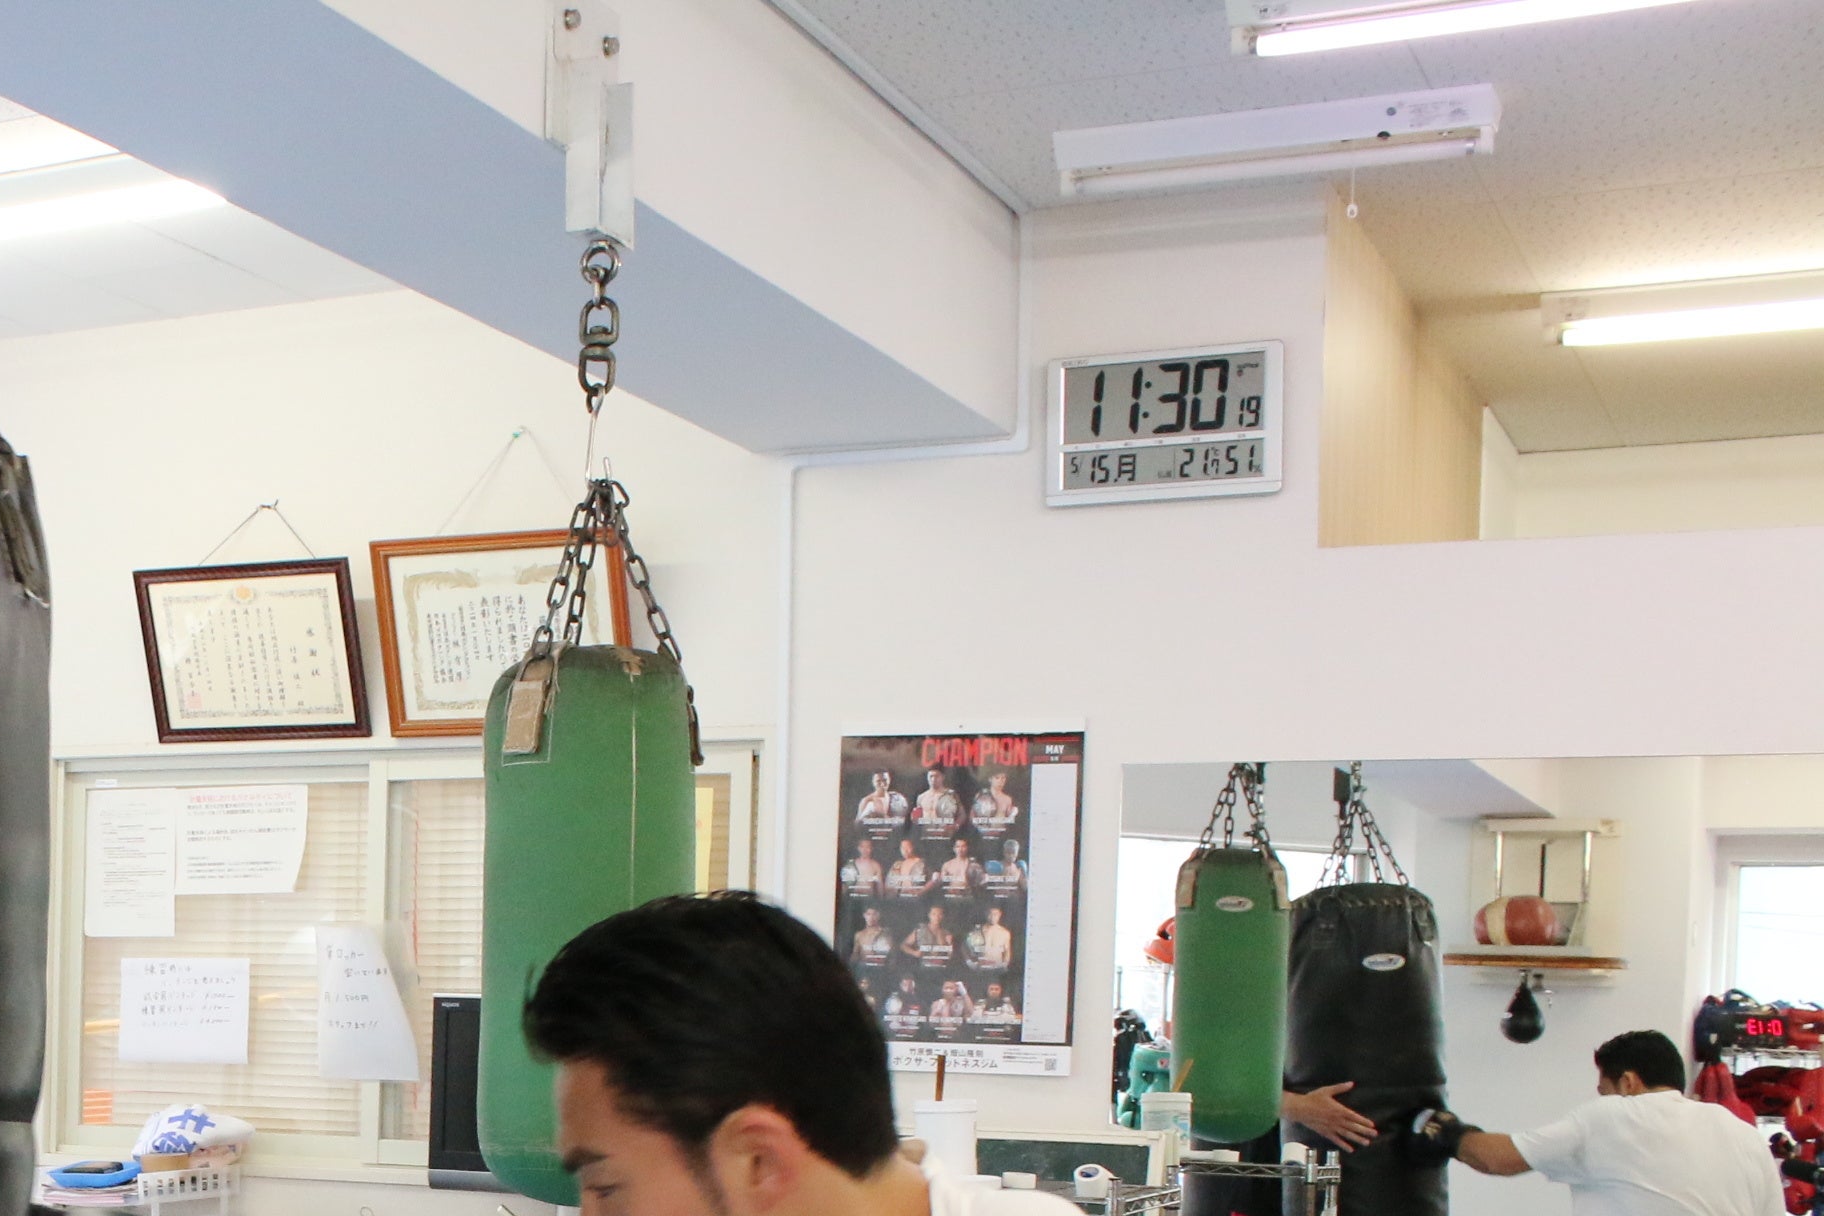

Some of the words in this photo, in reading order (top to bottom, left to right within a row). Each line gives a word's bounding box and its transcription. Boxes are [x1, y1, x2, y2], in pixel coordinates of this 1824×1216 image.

[1090, 358, 1229, 438] 11:30
[1238, 395, 1262, 428] 19
[920, 736, 1029, 768] CHAMPION
[1045, 744, 1065, 755] MAY
